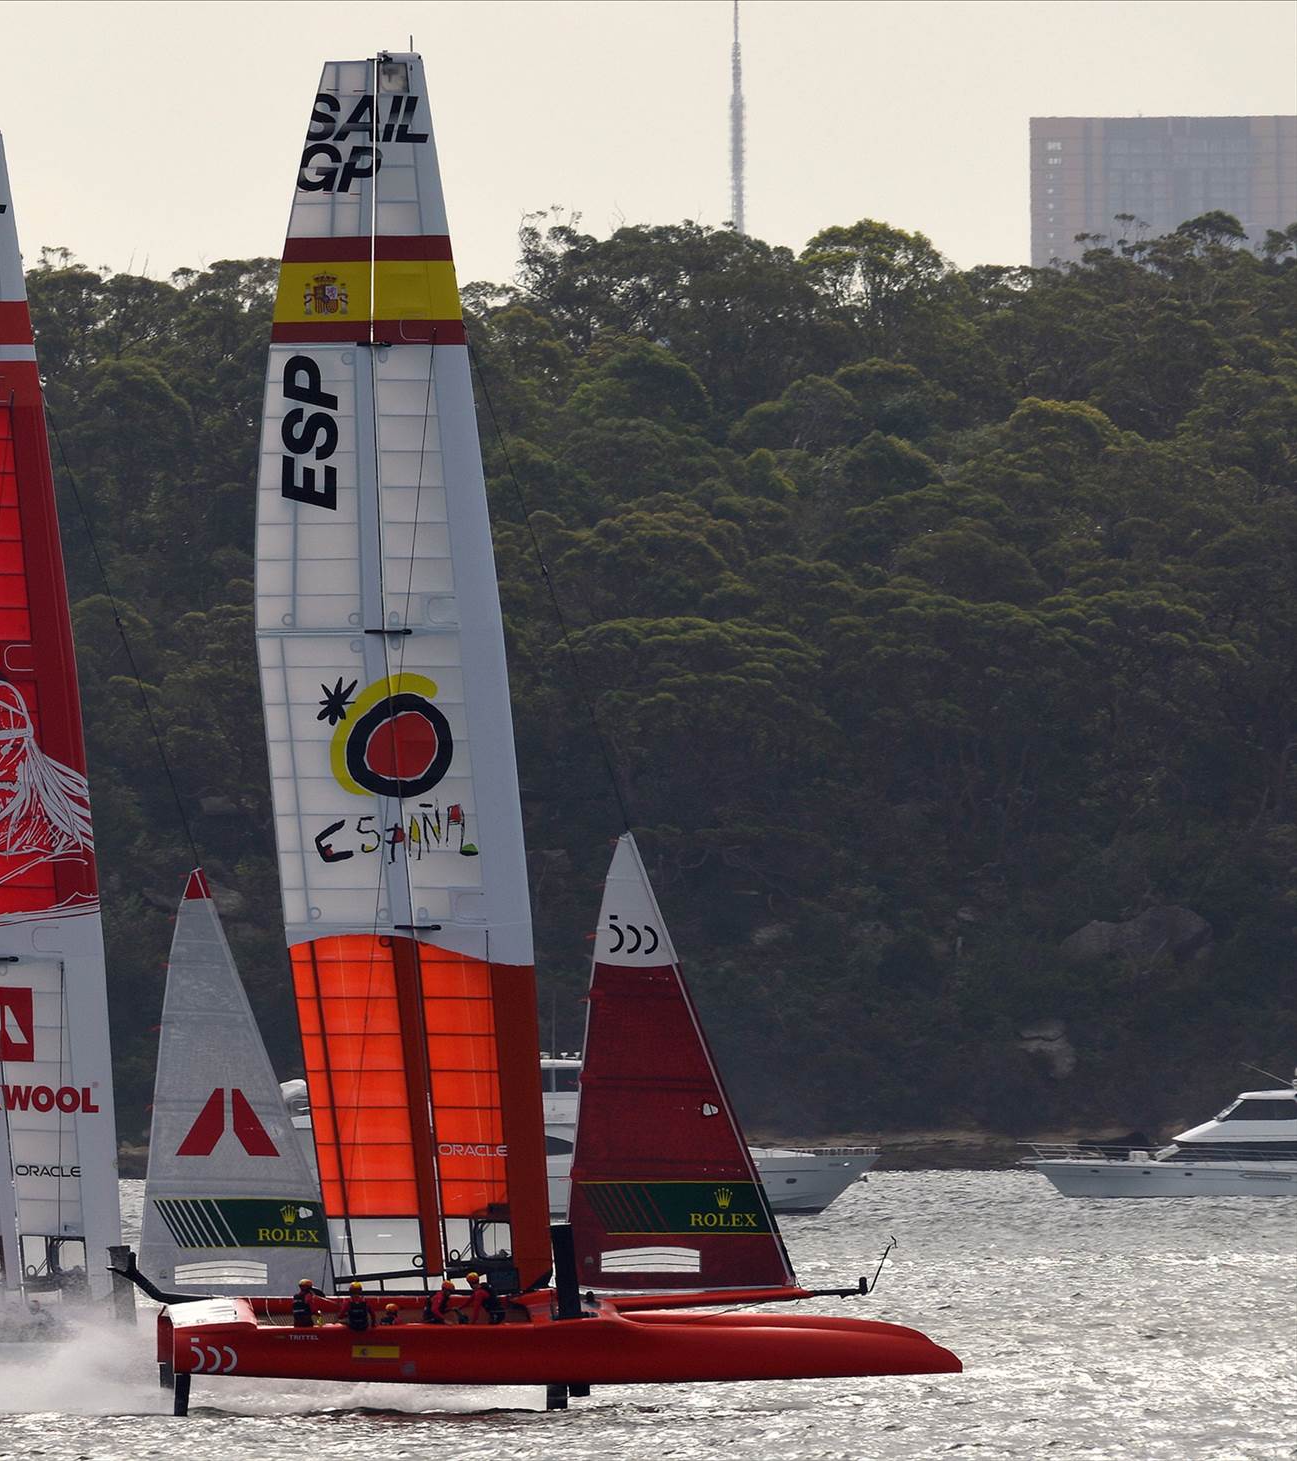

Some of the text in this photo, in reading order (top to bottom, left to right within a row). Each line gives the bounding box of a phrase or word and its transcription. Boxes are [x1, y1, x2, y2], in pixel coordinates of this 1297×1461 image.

[307, 93, 429, 143] SAIL
[297, 143, 384, 192] GP
[281, 355, 338, 510] ESP
[438, 1144, 508, 1157] ORACLE
[15, 1164, 81, 1178] ORACLE
[689, 1213, 758, 1227] ROLEX
[257, 1228, 319, 1243] ROLEX
